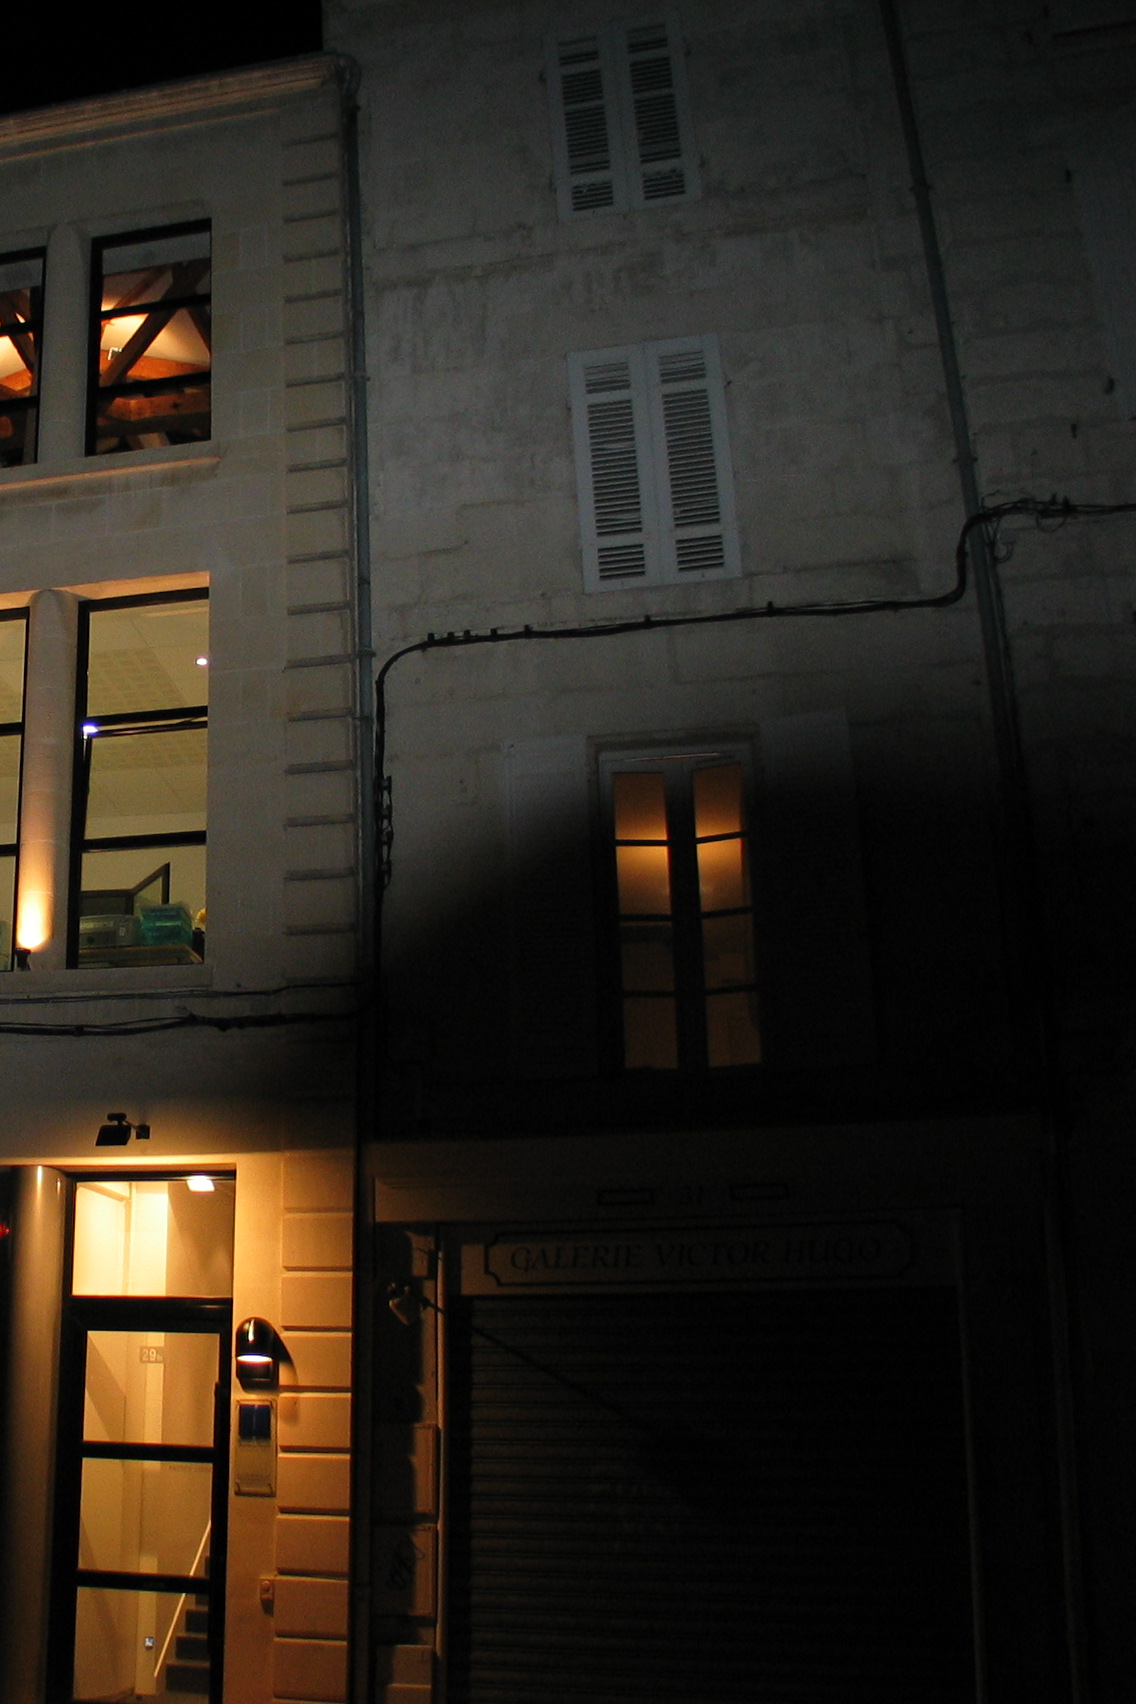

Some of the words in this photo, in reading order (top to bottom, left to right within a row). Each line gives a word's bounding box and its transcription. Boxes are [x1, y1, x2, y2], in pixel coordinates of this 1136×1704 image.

[509, 1243, 643, 1275] GALERIE
[655, 1240, 770, 1269] VICTOR
[783, 1236, 882, 1266] HUGO
